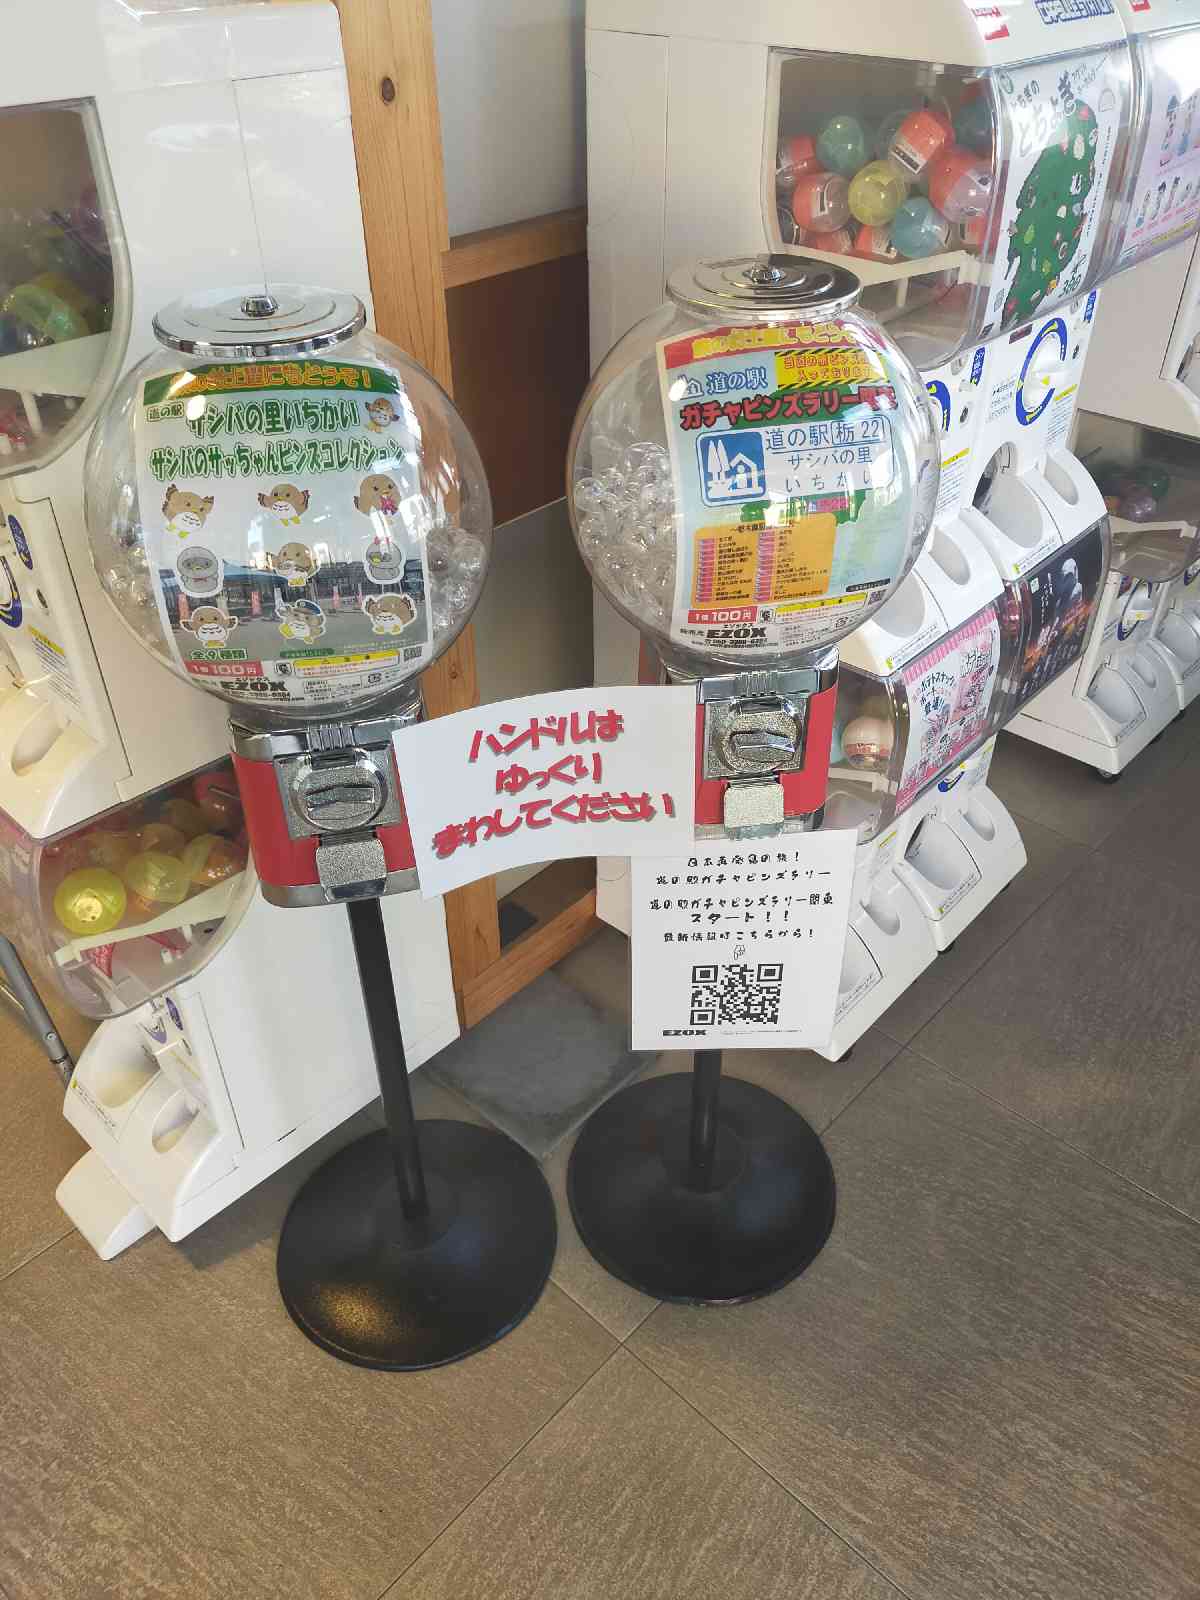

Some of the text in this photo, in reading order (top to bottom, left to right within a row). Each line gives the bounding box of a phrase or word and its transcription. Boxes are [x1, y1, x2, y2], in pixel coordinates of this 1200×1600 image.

[707, 366, 768, 394] 道の駅
[765, 423, 830, 450] 道の駅
[787, 446, 873, 470] サシバの里
[468, 709, 625, 763] ハンドルは
[495, 752, 603, 795] ゆっくり
[432, 792, 676, 860] まわしてください
